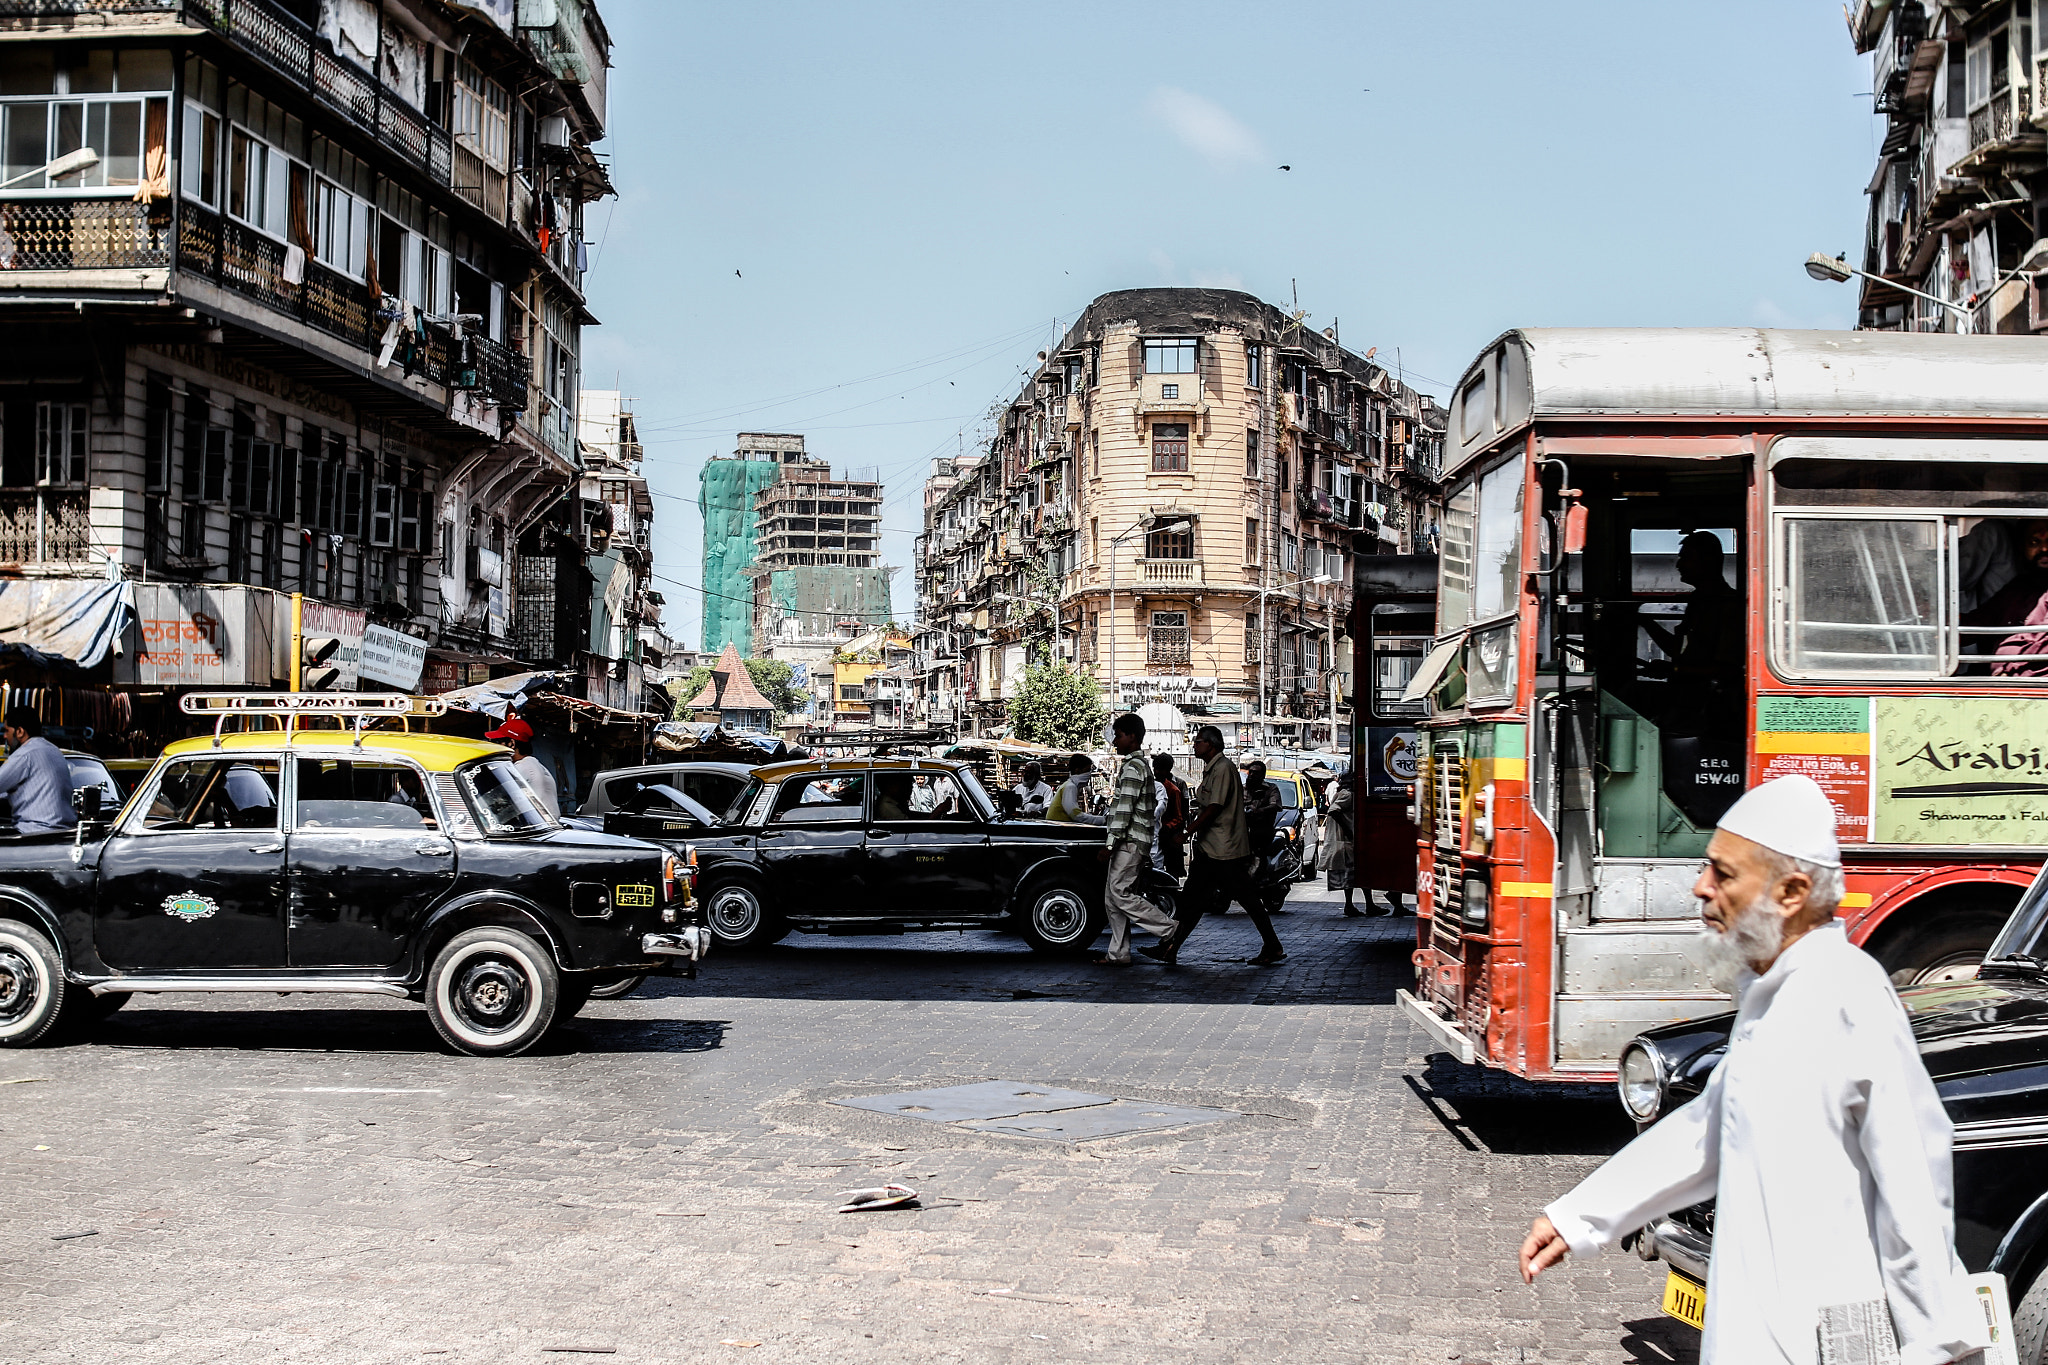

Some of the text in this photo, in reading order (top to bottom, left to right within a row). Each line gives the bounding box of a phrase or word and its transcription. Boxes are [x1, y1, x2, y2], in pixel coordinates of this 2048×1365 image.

[212, 350, 275, 396] HOSTEL
[1896, 741, 2048, 775] Arabi
[1695, 773, 1740, 784] 15W40
[1919, 810, 2006, 821] Shawarmas
